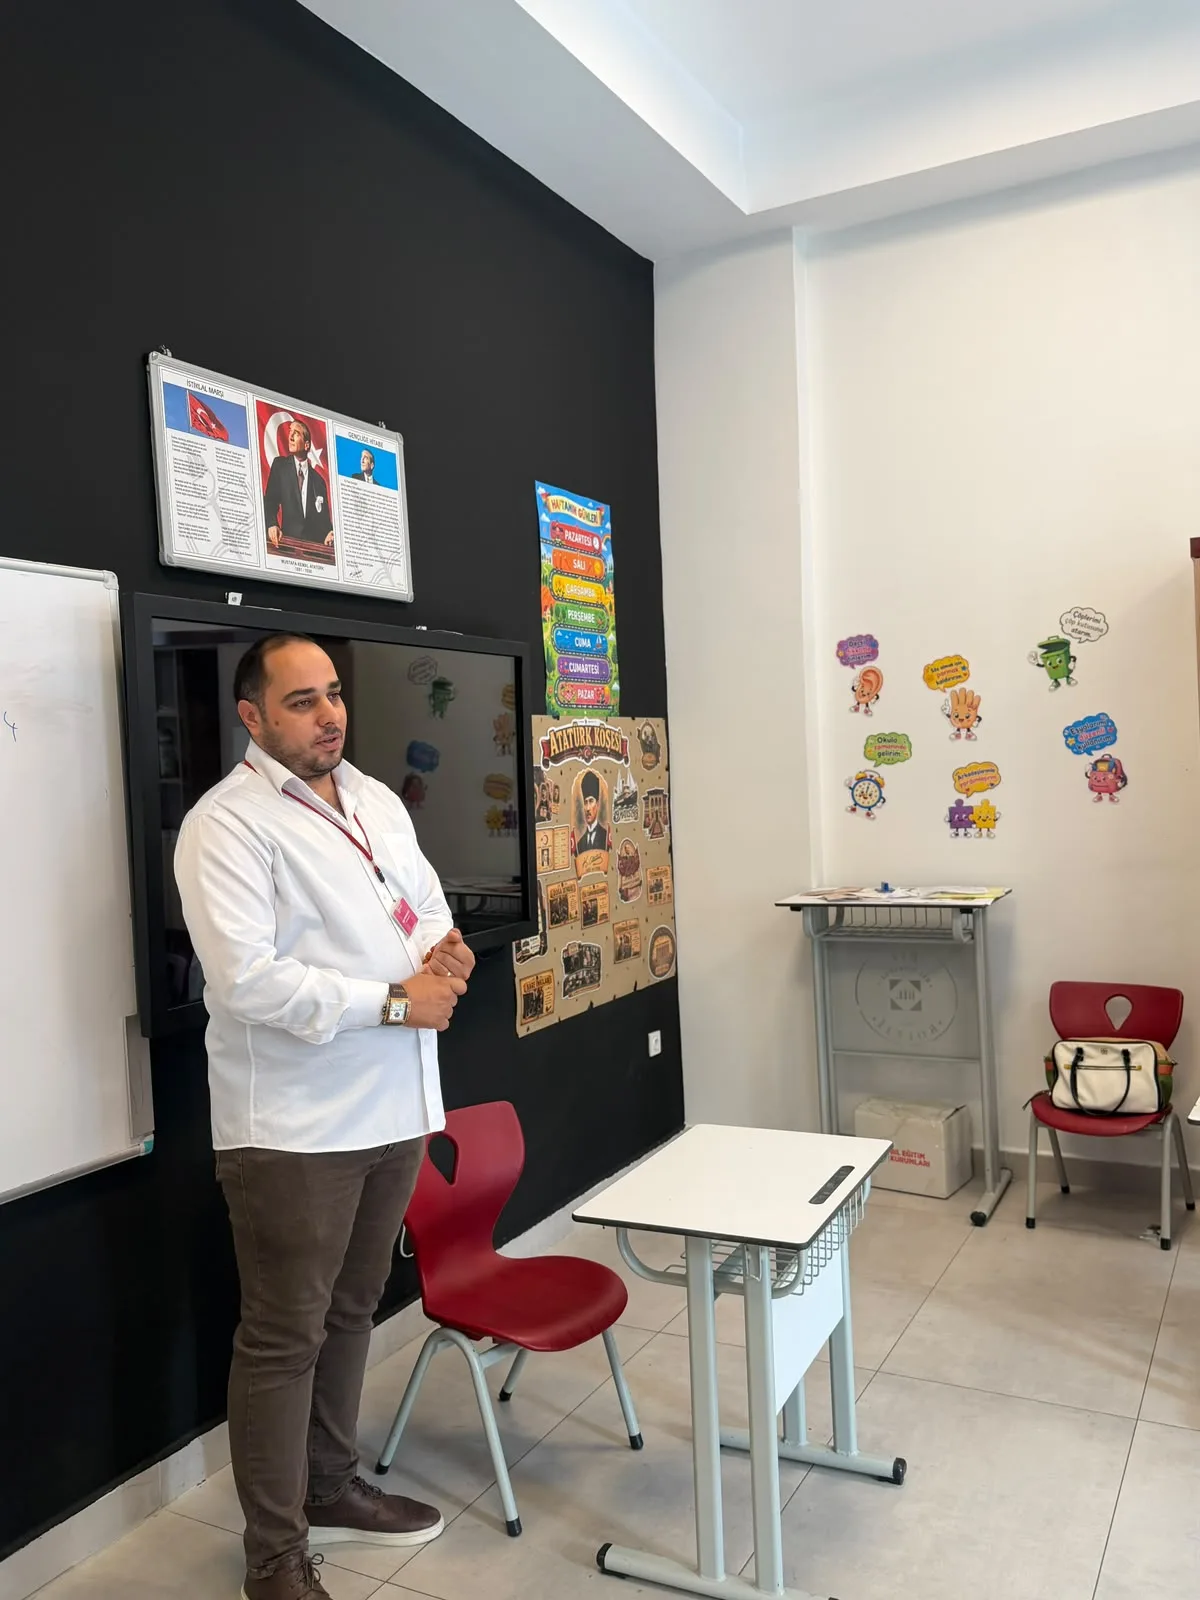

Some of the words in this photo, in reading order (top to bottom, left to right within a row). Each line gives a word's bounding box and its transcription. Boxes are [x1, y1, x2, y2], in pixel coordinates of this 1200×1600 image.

[187, 379, 208, 393] İSTİKLAL
[550, 498, 577, 517] HAFTANIN
[564, 529, 593, 547] PAZARTESİ
[572, 559, 586, 571] SALI
[566, 583, 595, 598] ÇARŞAMBA
[567, 609, 595, 624] PERŞEMBE
[1073, 610, 1102, 624] Çöplerimi
[574, 636, 592, 648] CUMA
[568, 662, 600, 675] CUMARTESİ
[577, 689, 595, 700] PAZAR
[550, 726, 592, 757] ATATÜRK
[594, 726, 622, 754] KÖŞESİ
[877, 736, 898, 744] Okula
